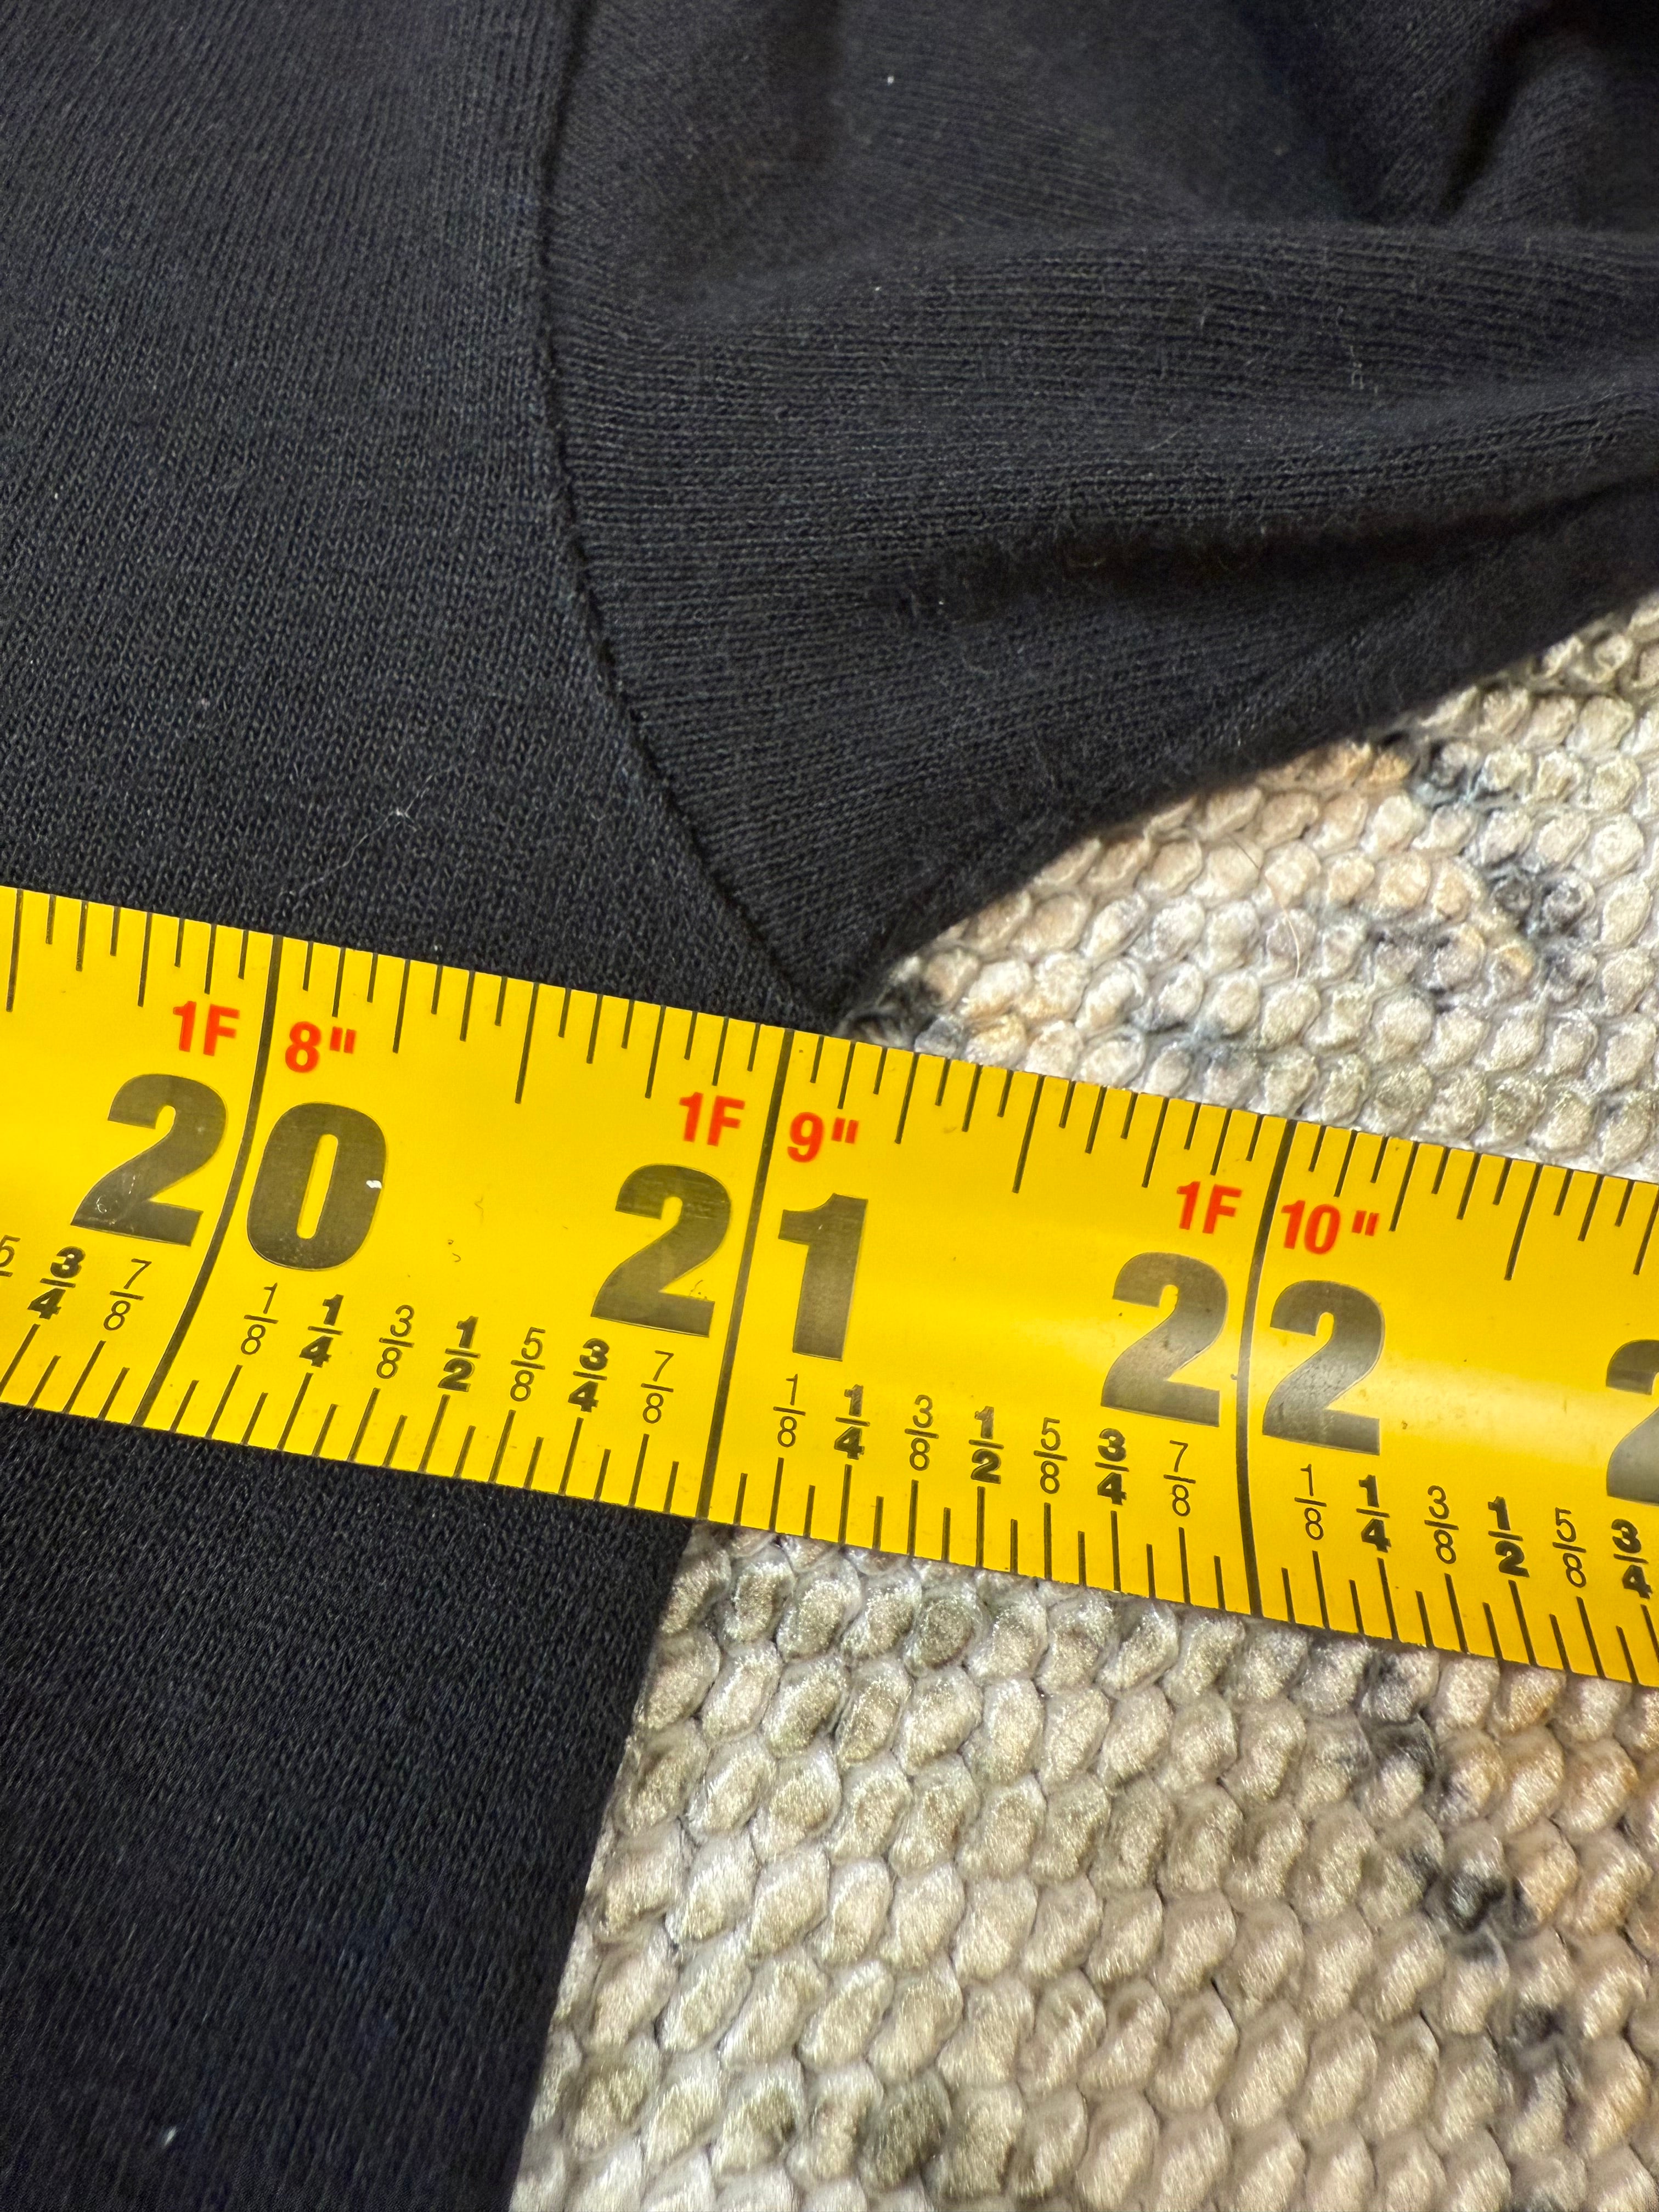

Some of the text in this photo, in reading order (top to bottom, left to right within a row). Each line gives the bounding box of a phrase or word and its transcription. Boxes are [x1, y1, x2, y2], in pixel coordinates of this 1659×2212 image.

[173, 1000, 240, 1057] 1F
[679, 1091, 746, 1147] 1F
[1176, 1180, 1243, 1235] 1F
